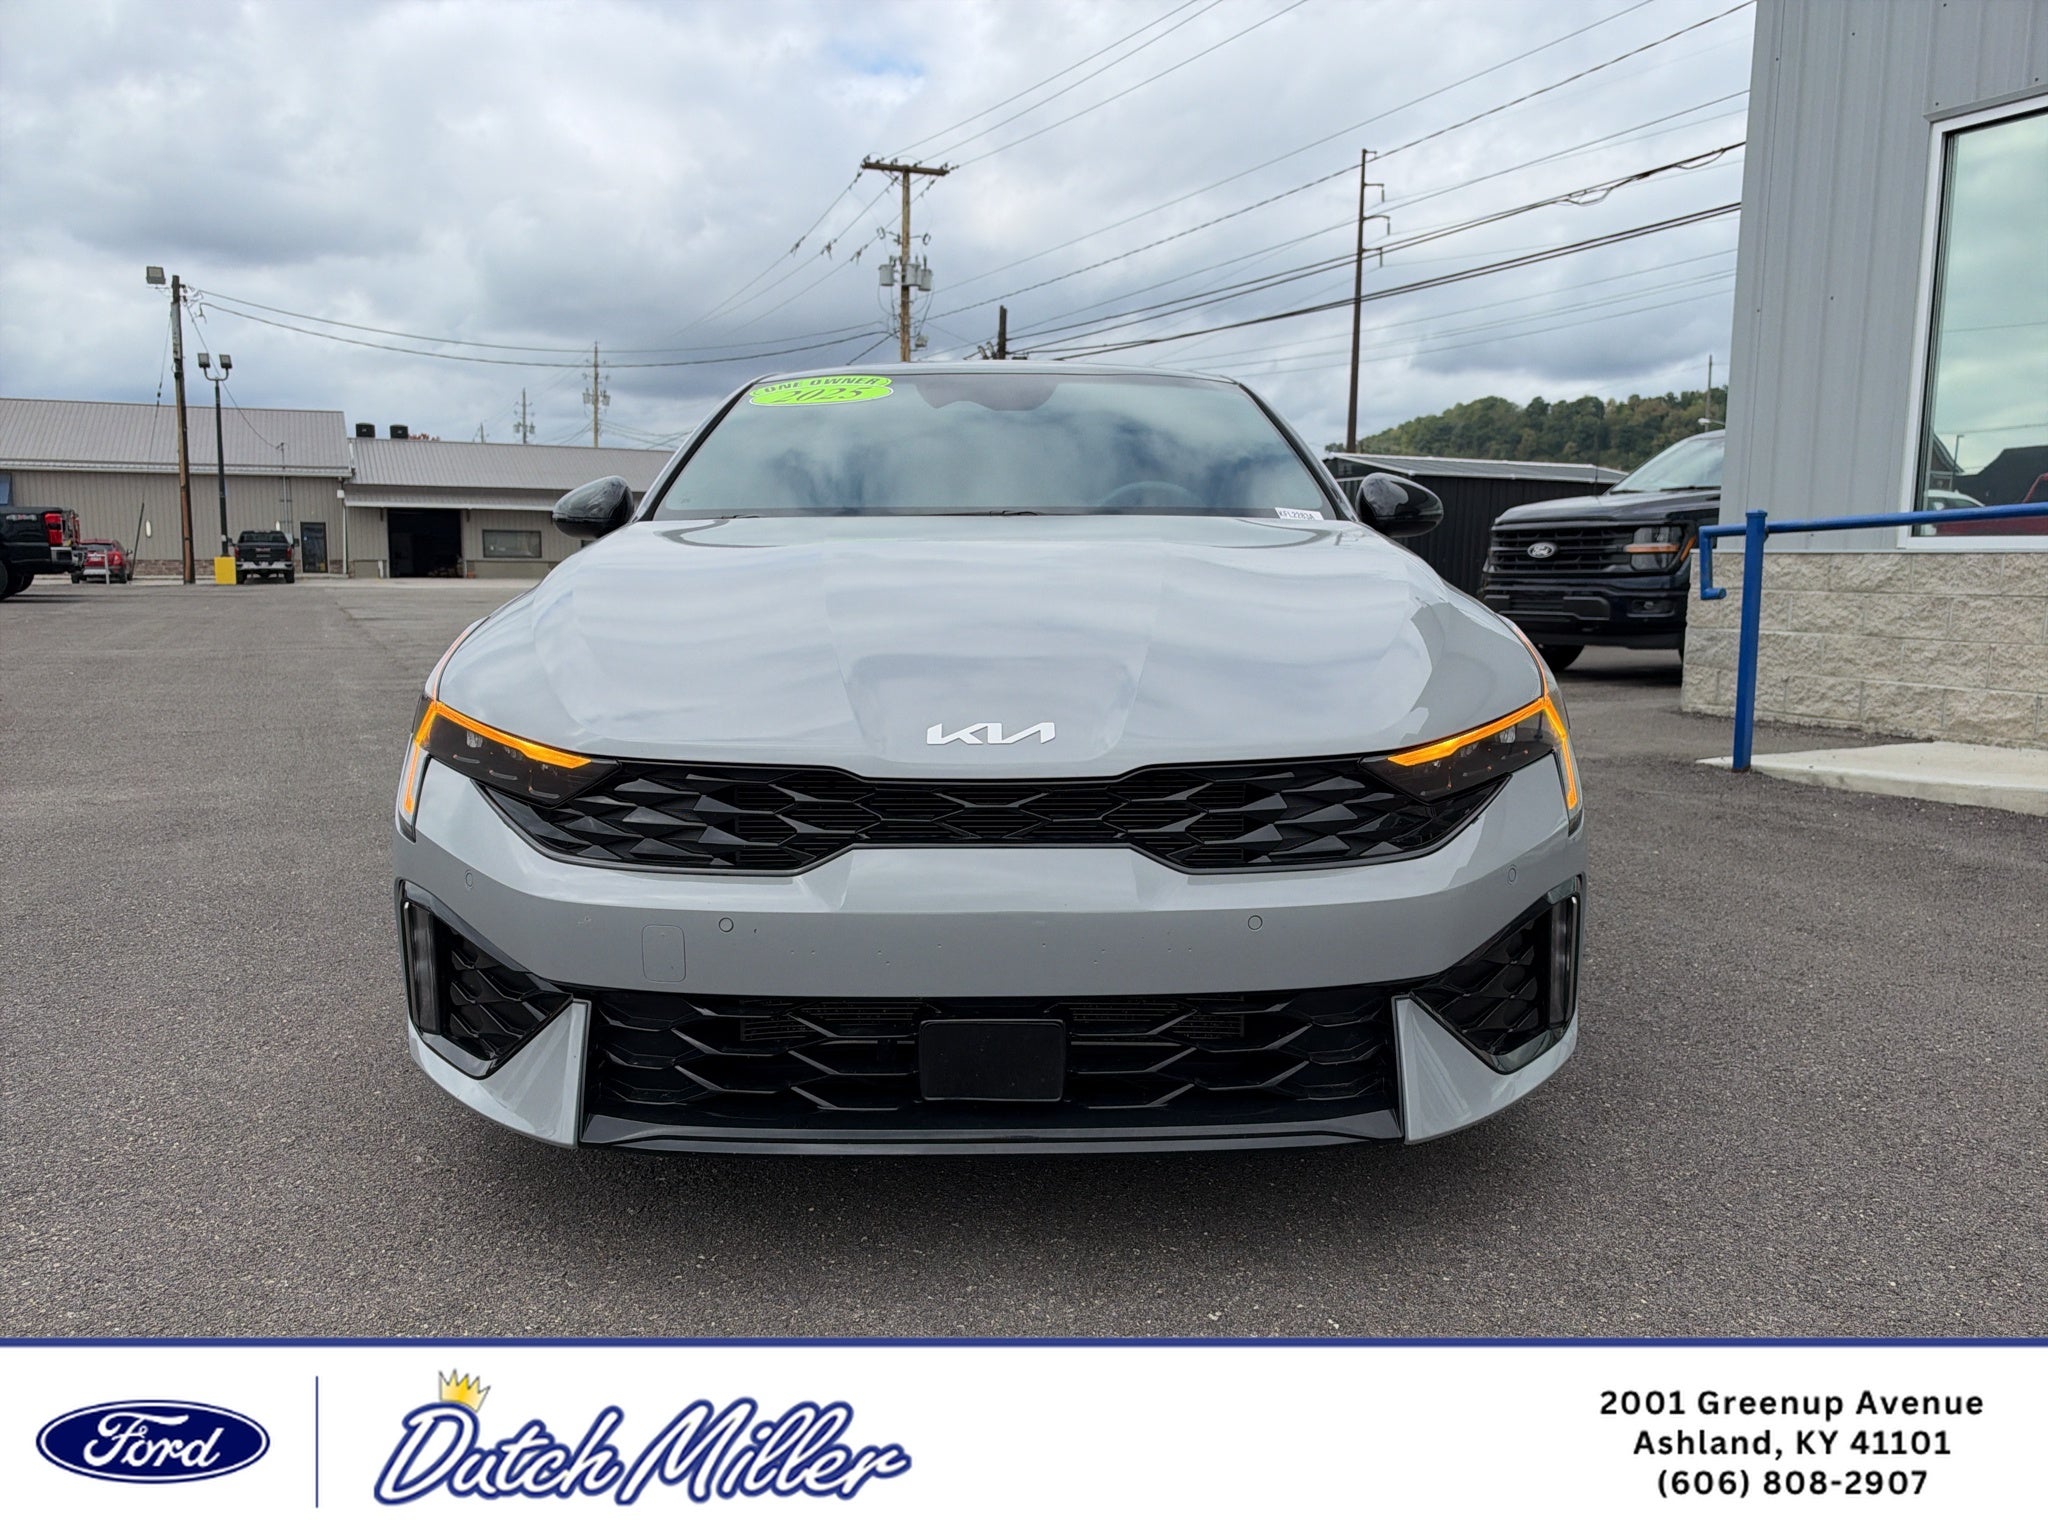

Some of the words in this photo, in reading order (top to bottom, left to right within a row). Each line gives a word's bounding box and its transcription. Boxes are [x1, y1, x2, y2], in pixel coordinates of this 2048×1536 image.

[764, 382, 800, 393] ONE
[810, 377, 880, 386] OWNER
[774, 387, 871, 402] 2025
[927, 722, 1056, 745] KIA
